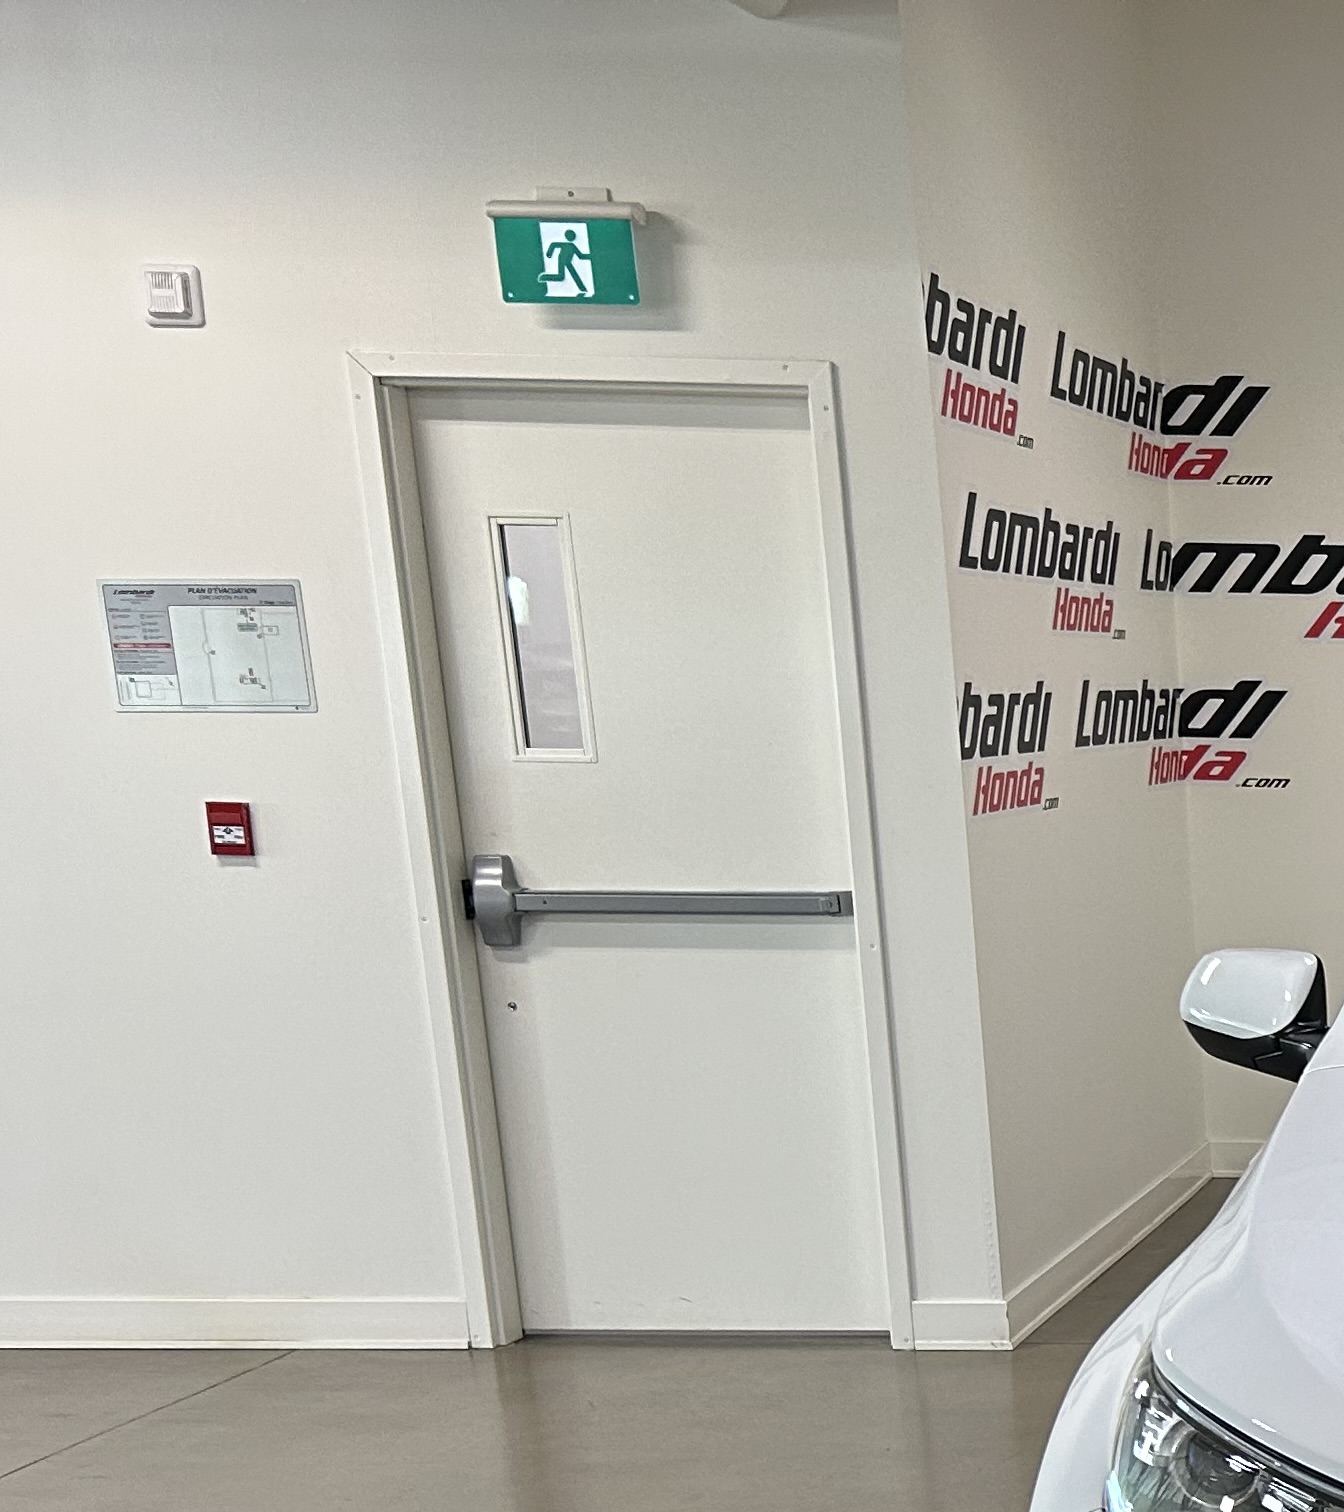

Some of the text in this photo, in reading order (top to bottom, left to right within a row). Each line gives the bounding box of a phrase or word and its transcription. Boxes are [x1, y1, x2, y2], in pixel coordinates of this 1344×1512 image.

[925, 272, 1026, 384] bardi
[941, 368, 1018, 436] Honda
[1050, 330, 1271, 436] Lombardi
[1217, 475, 1273, 486] .com
[959, 492, 1120, 585] Lombardi
[1052, 587, 1114, 633] Honda
[958, 680, 1053, 760] bardi
[1075, 679, 1289, 748] Lombardi
[973, 761, 1045, 816] Honda
[1235, 778, 1290, 788] .com
